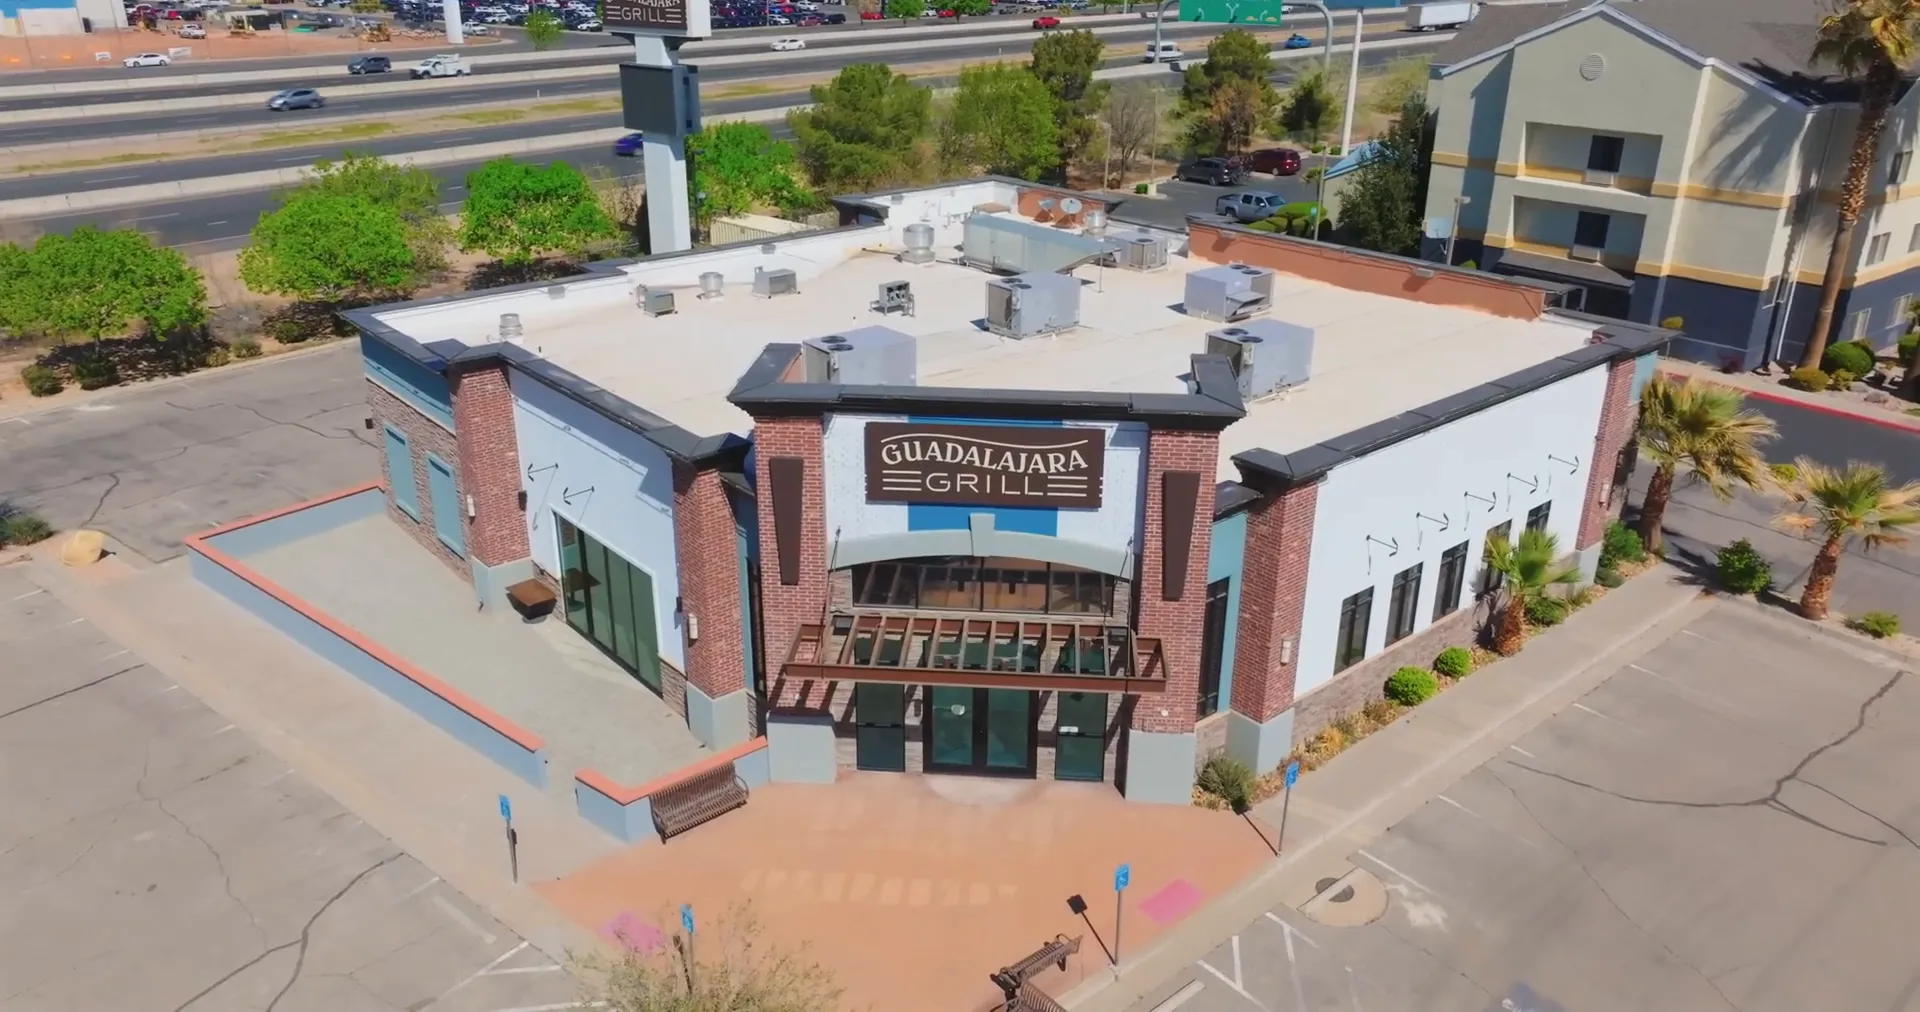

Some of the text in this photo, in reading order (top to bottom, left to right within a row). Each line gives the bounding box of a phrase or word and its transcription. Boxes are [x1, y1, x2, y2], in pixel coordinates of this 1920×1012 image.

[621, 7, 665, 23] GRILL
[881, 441, 1088, 474] GUADALAJARA
[926, 473, 1043, 496] GRILL
